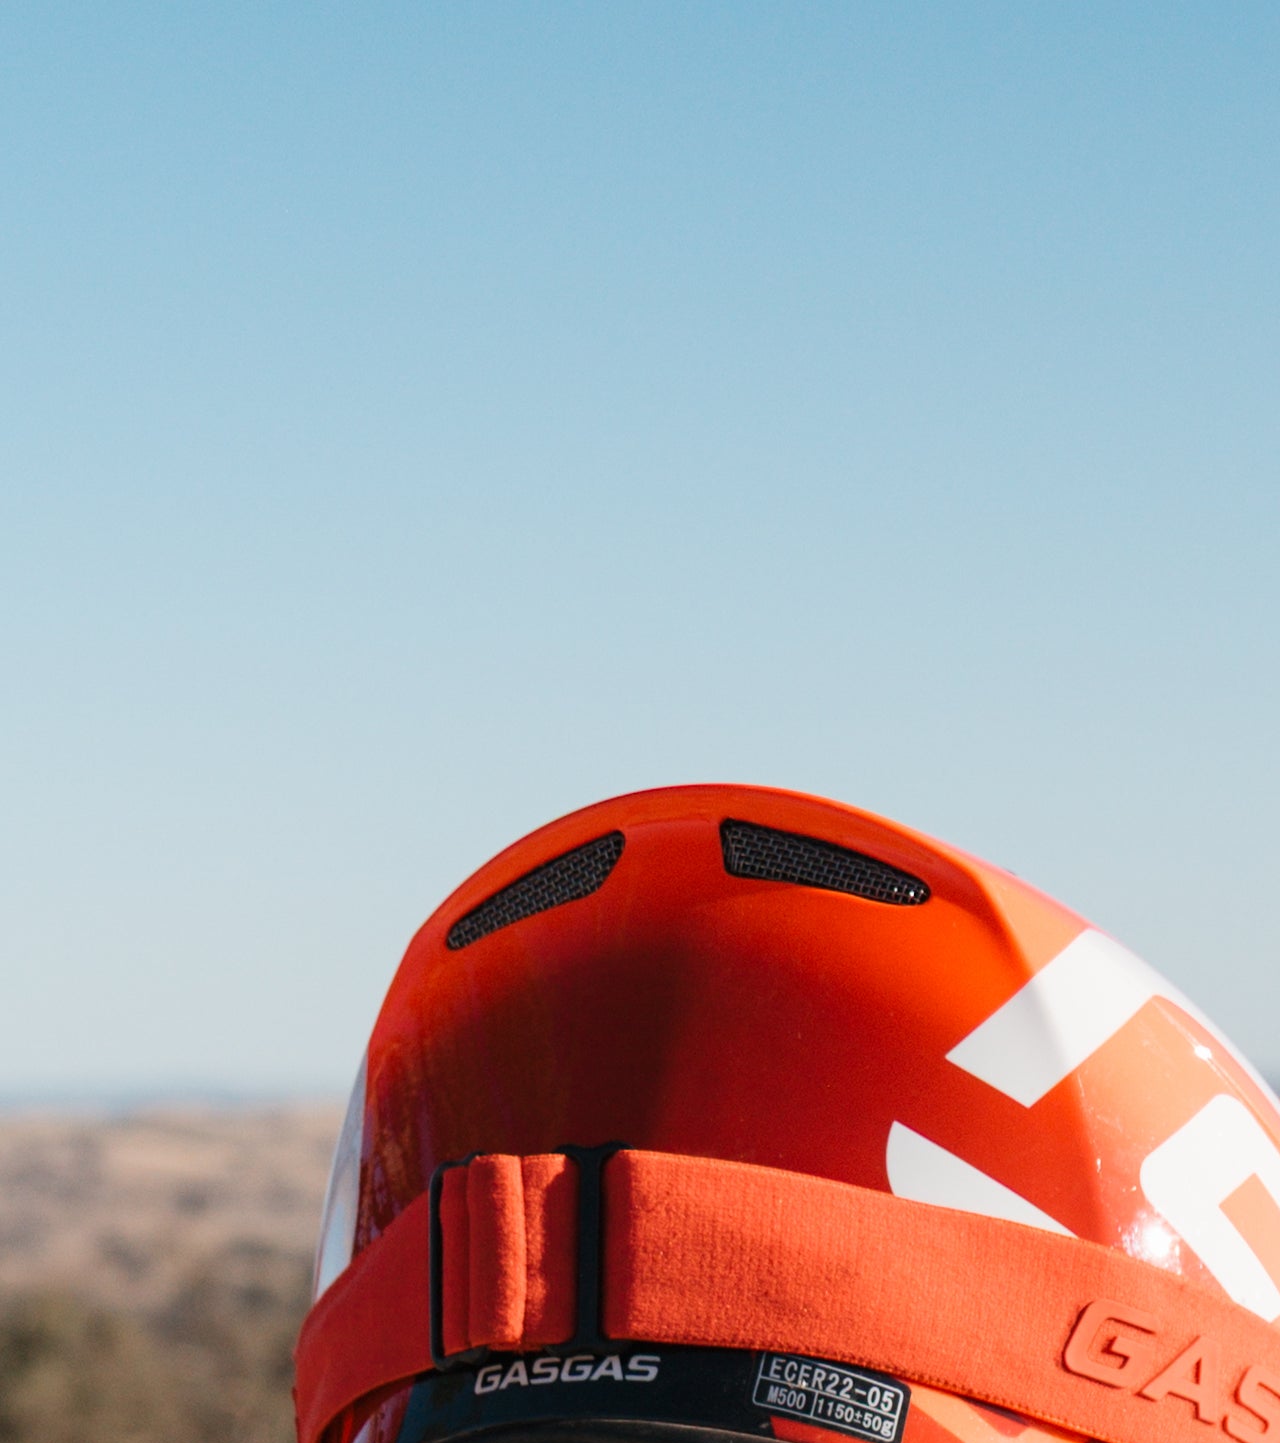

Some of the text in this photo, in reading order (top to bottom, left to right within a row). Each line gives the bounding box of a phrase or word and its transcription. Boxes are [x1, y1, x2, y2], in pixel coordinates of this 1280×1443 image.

[473, 1354, 661, 1395] GASGAS
[767, 1386, 895, 1437] M500 1150±50g
